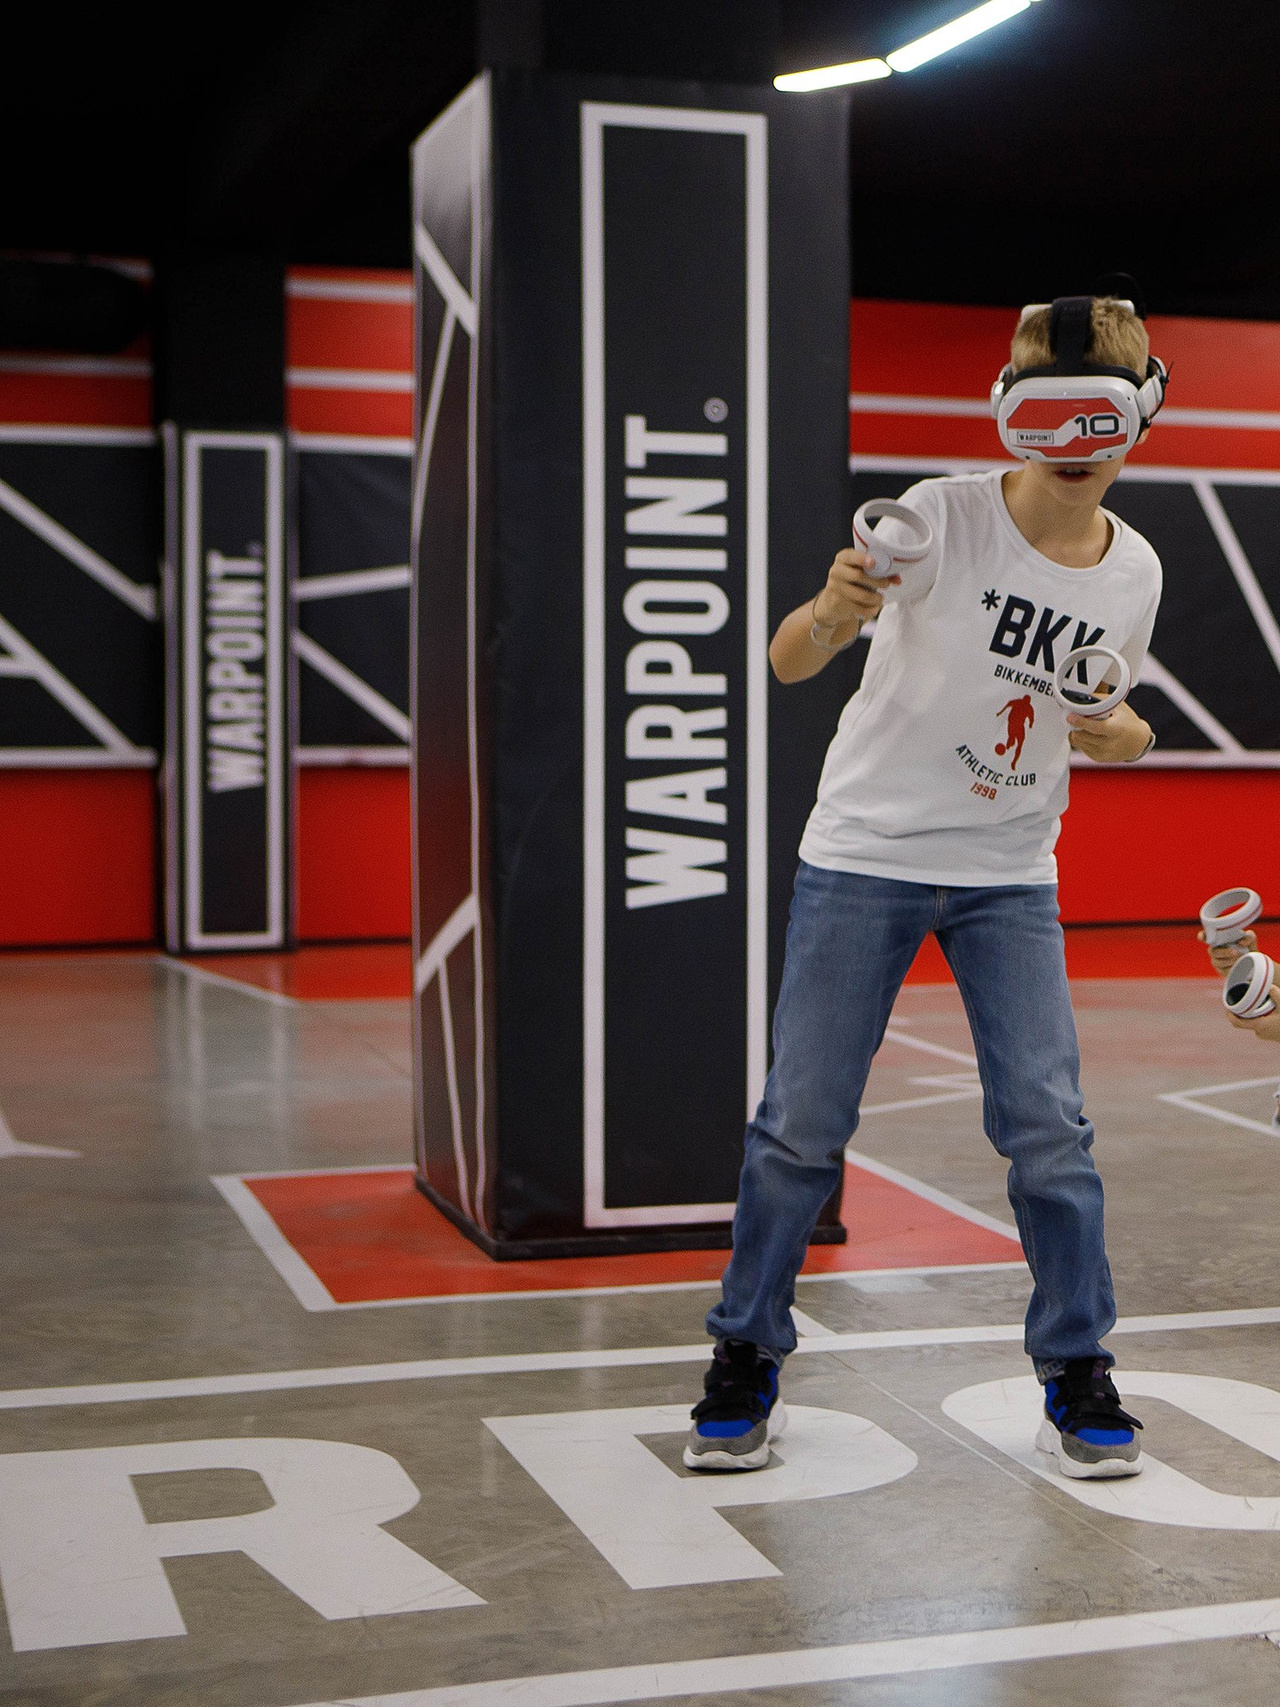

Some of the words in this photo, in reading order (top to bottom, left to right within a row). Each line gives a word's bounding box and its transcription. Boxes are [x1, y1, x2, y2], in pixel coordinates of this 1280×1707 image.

[1074, 415, 1119, 437] 10
[207, 550, 264, 793] WARPOINT
[622, 414, 730, 910] WARPOINT
[994, 664, 1055, 697] BIKKEMBE
[955, 744, 1003, 784] ATHLETIC
[1005, 772, 1037, 787] CLUB
[970, 781, 998, 801] 1998
